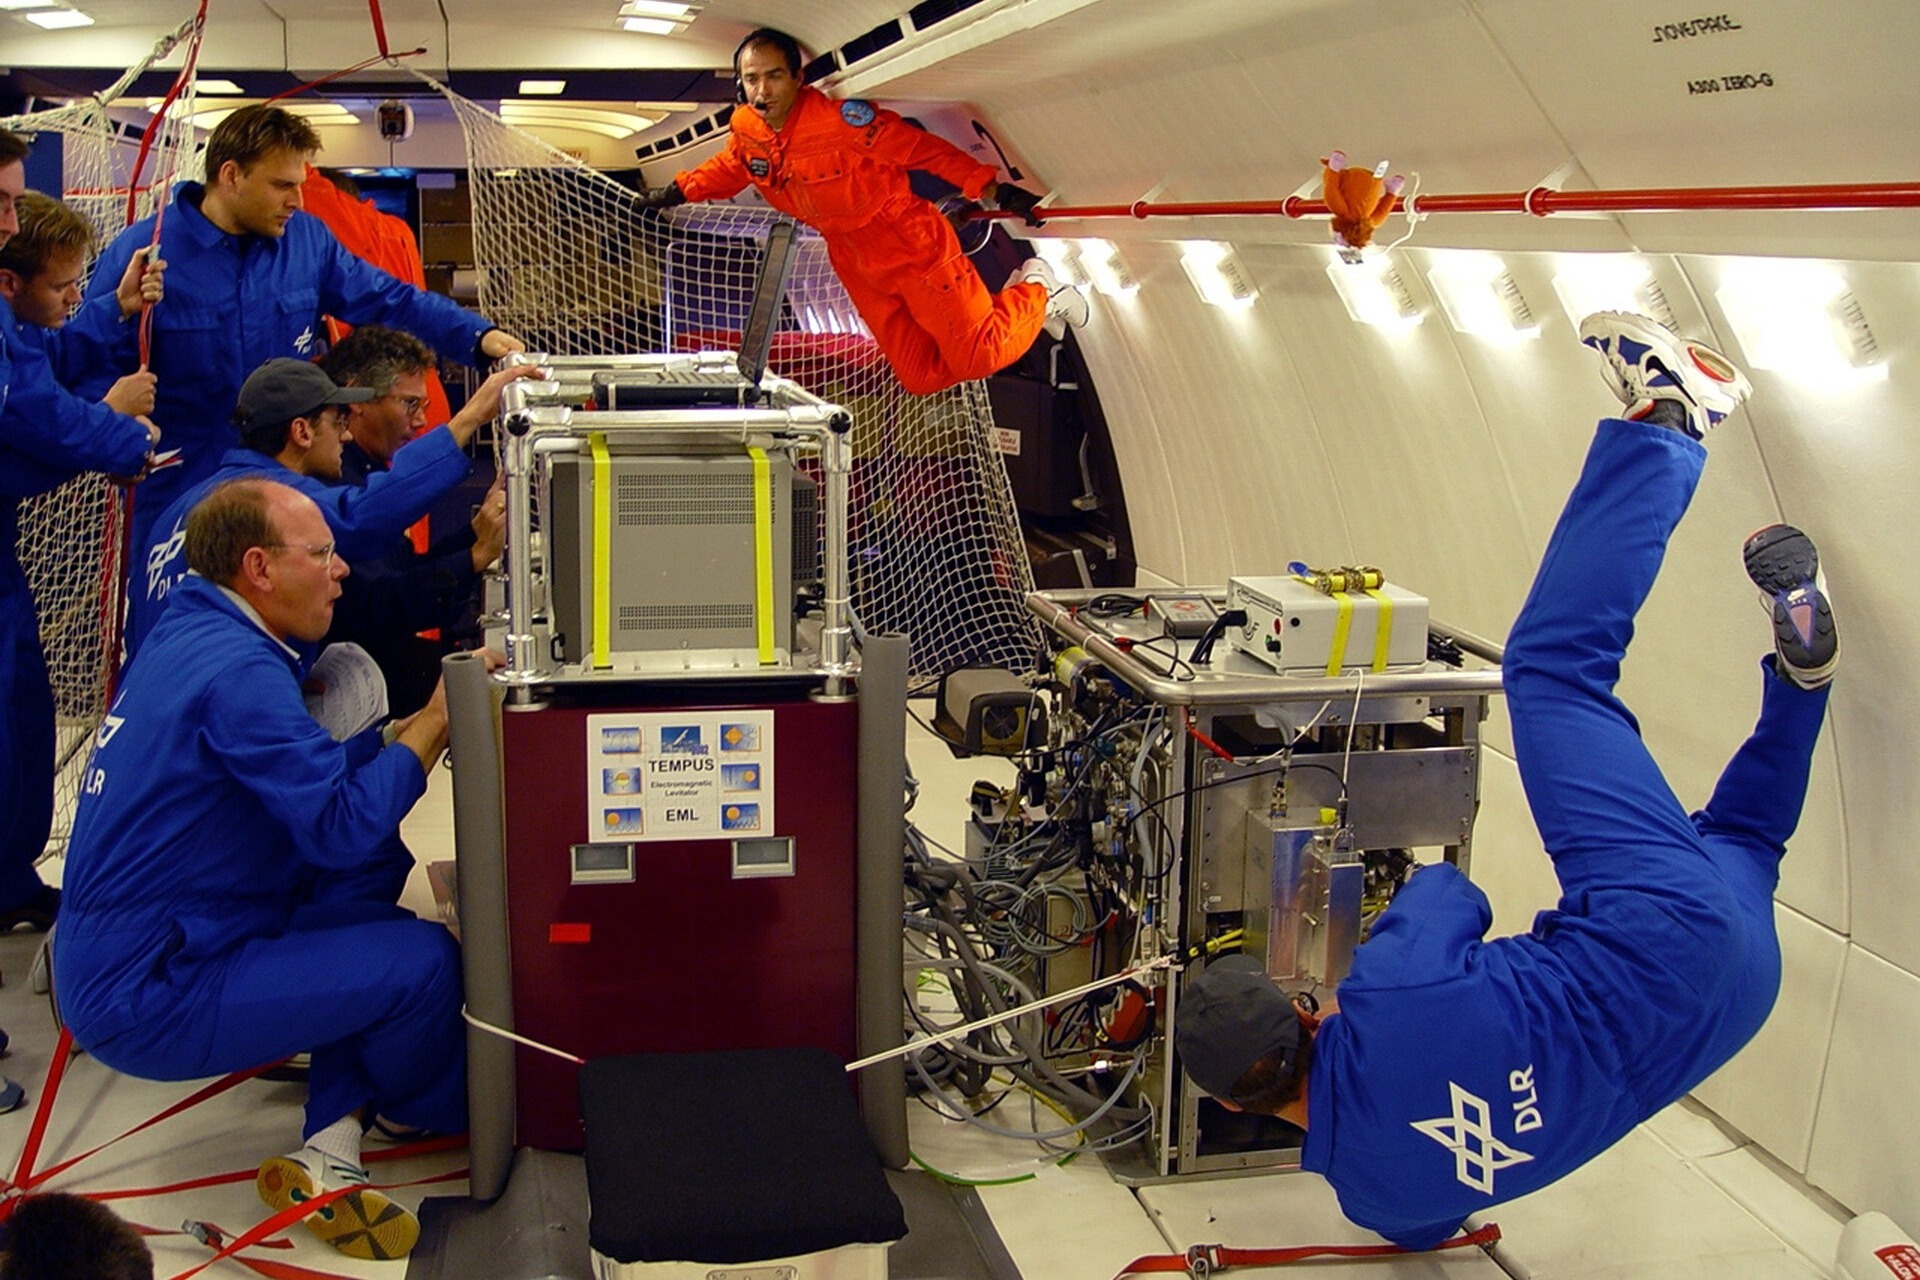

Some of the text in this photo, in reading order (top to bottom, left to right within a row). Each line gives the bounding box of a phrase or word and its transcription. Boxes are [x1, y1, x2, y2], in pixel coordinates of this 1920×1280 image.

[1687, 73, 1774, 95] A300 ZERO-G
[649, 758, 714, 773] TEMPUS
[650, 780, 713, 789] Electromagnetic
[665, 789, 699, 797] Levitator
[666, 808, 700, 822] EML
[1509, 1063, 1543, 1134] DLR
